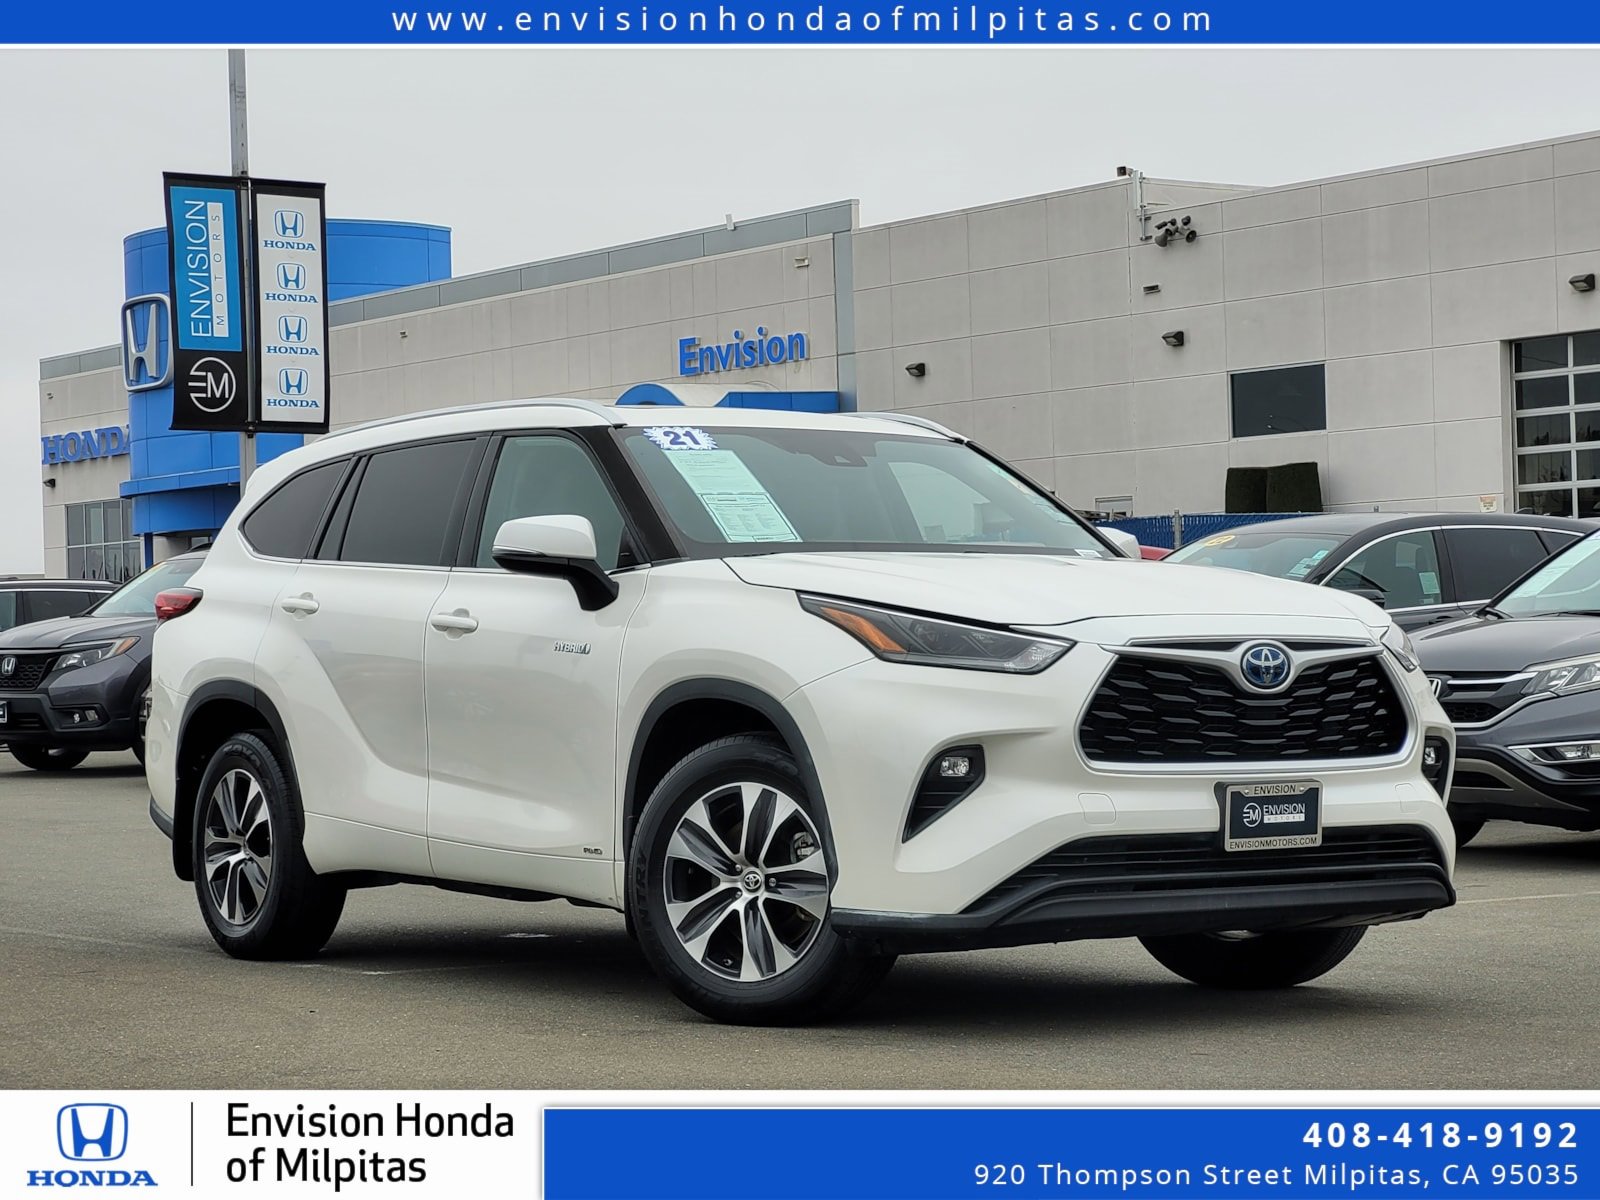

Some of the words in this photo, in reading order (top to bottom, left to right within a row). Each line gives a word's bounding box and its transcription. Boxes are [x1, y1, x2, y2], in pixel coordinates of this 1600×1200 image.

[263, 240, 317, 251] HONDA
[185, 200, 211, 337] ENVISION
[211, 214, 225, 325] MOTORS
[264, 293, 318, 304] HONDA
[266, 345, 320, 356] HONDA
[679, 326, 807, 376] Envision
[266, 398, 320, 408] HONDA
[663, 430, 701, 445] 21
[1254, 785, 1296, 795] ENVISION
[1263, 803, 1305, 815] ENVISION
[1230, 837, 1317, 849] ENVISIONMOTORS.COM
